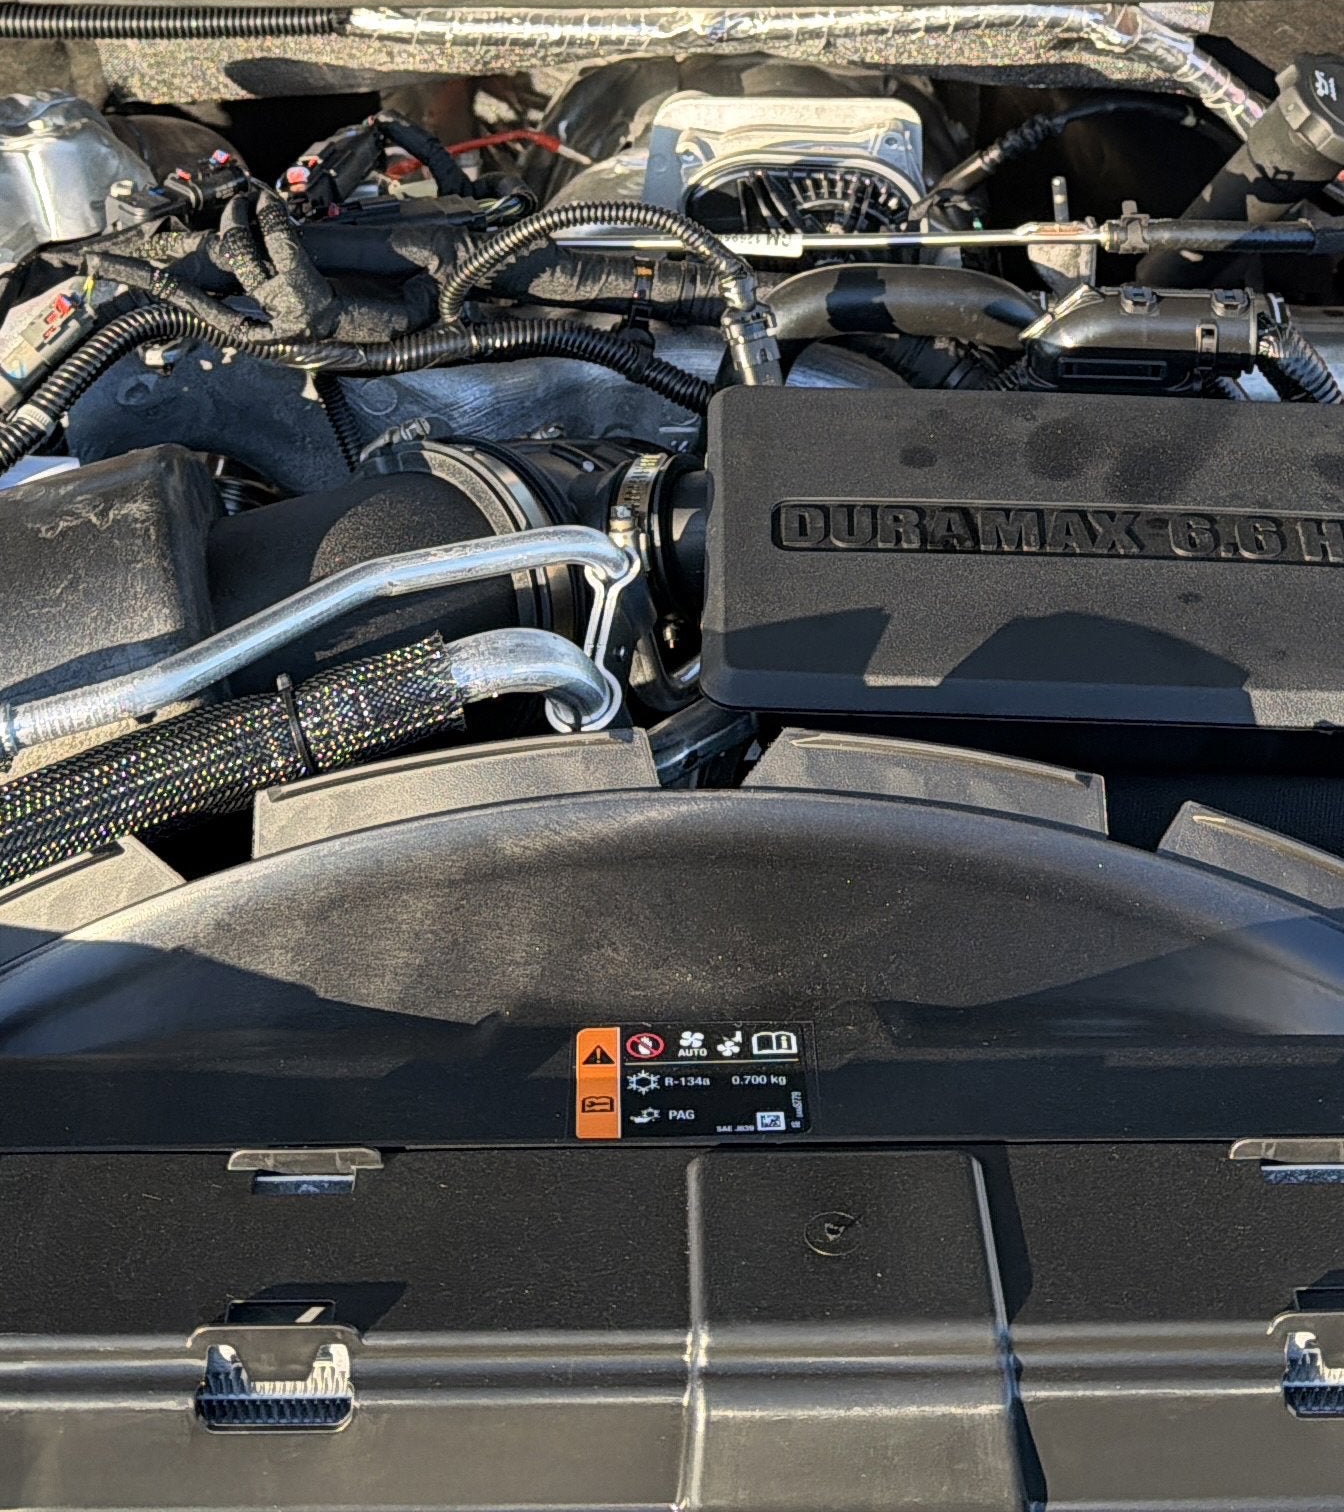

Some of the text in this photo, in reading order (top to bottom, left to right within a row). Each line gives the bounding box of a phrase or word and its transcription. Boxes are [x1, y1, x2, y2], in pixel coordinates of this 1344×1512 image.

[781, 504, 1143, 554] DURAMAX
[1168, 515, 1288, 560] 6.6
[678, 1048, 708, 1057] AUTO
[664, 1074, 787, 1087] R-134a 0.700 kg
[668, 1109, 695, 1121] PAG
